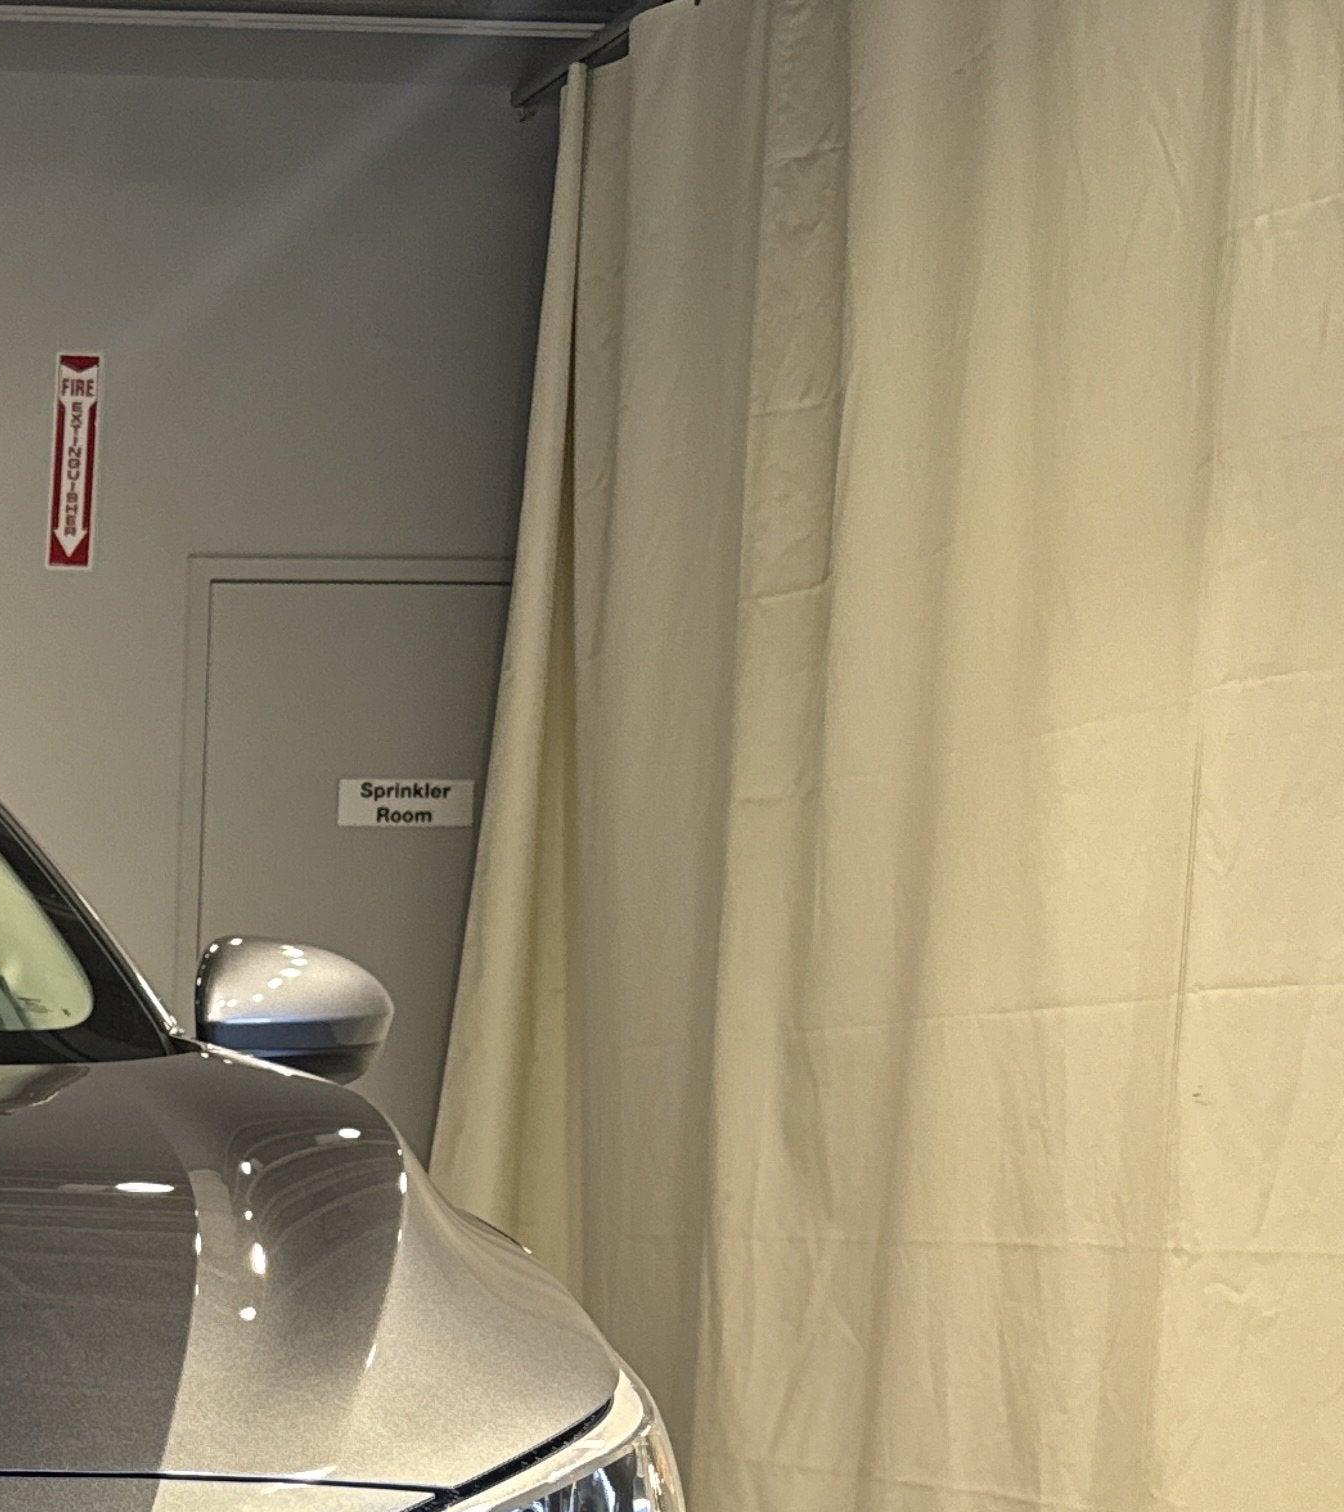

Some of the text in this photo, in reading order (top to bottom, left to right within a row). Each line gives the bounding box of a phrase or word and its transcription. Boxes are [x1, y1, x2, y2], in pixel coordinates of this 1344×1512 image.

[61, 378, 95, 397] FIRE
[64, 401, 82, 537] EXTINGUISHER
[360, 782, 451, 801] Sprinkler
[376, 807, 433, 823] Room
